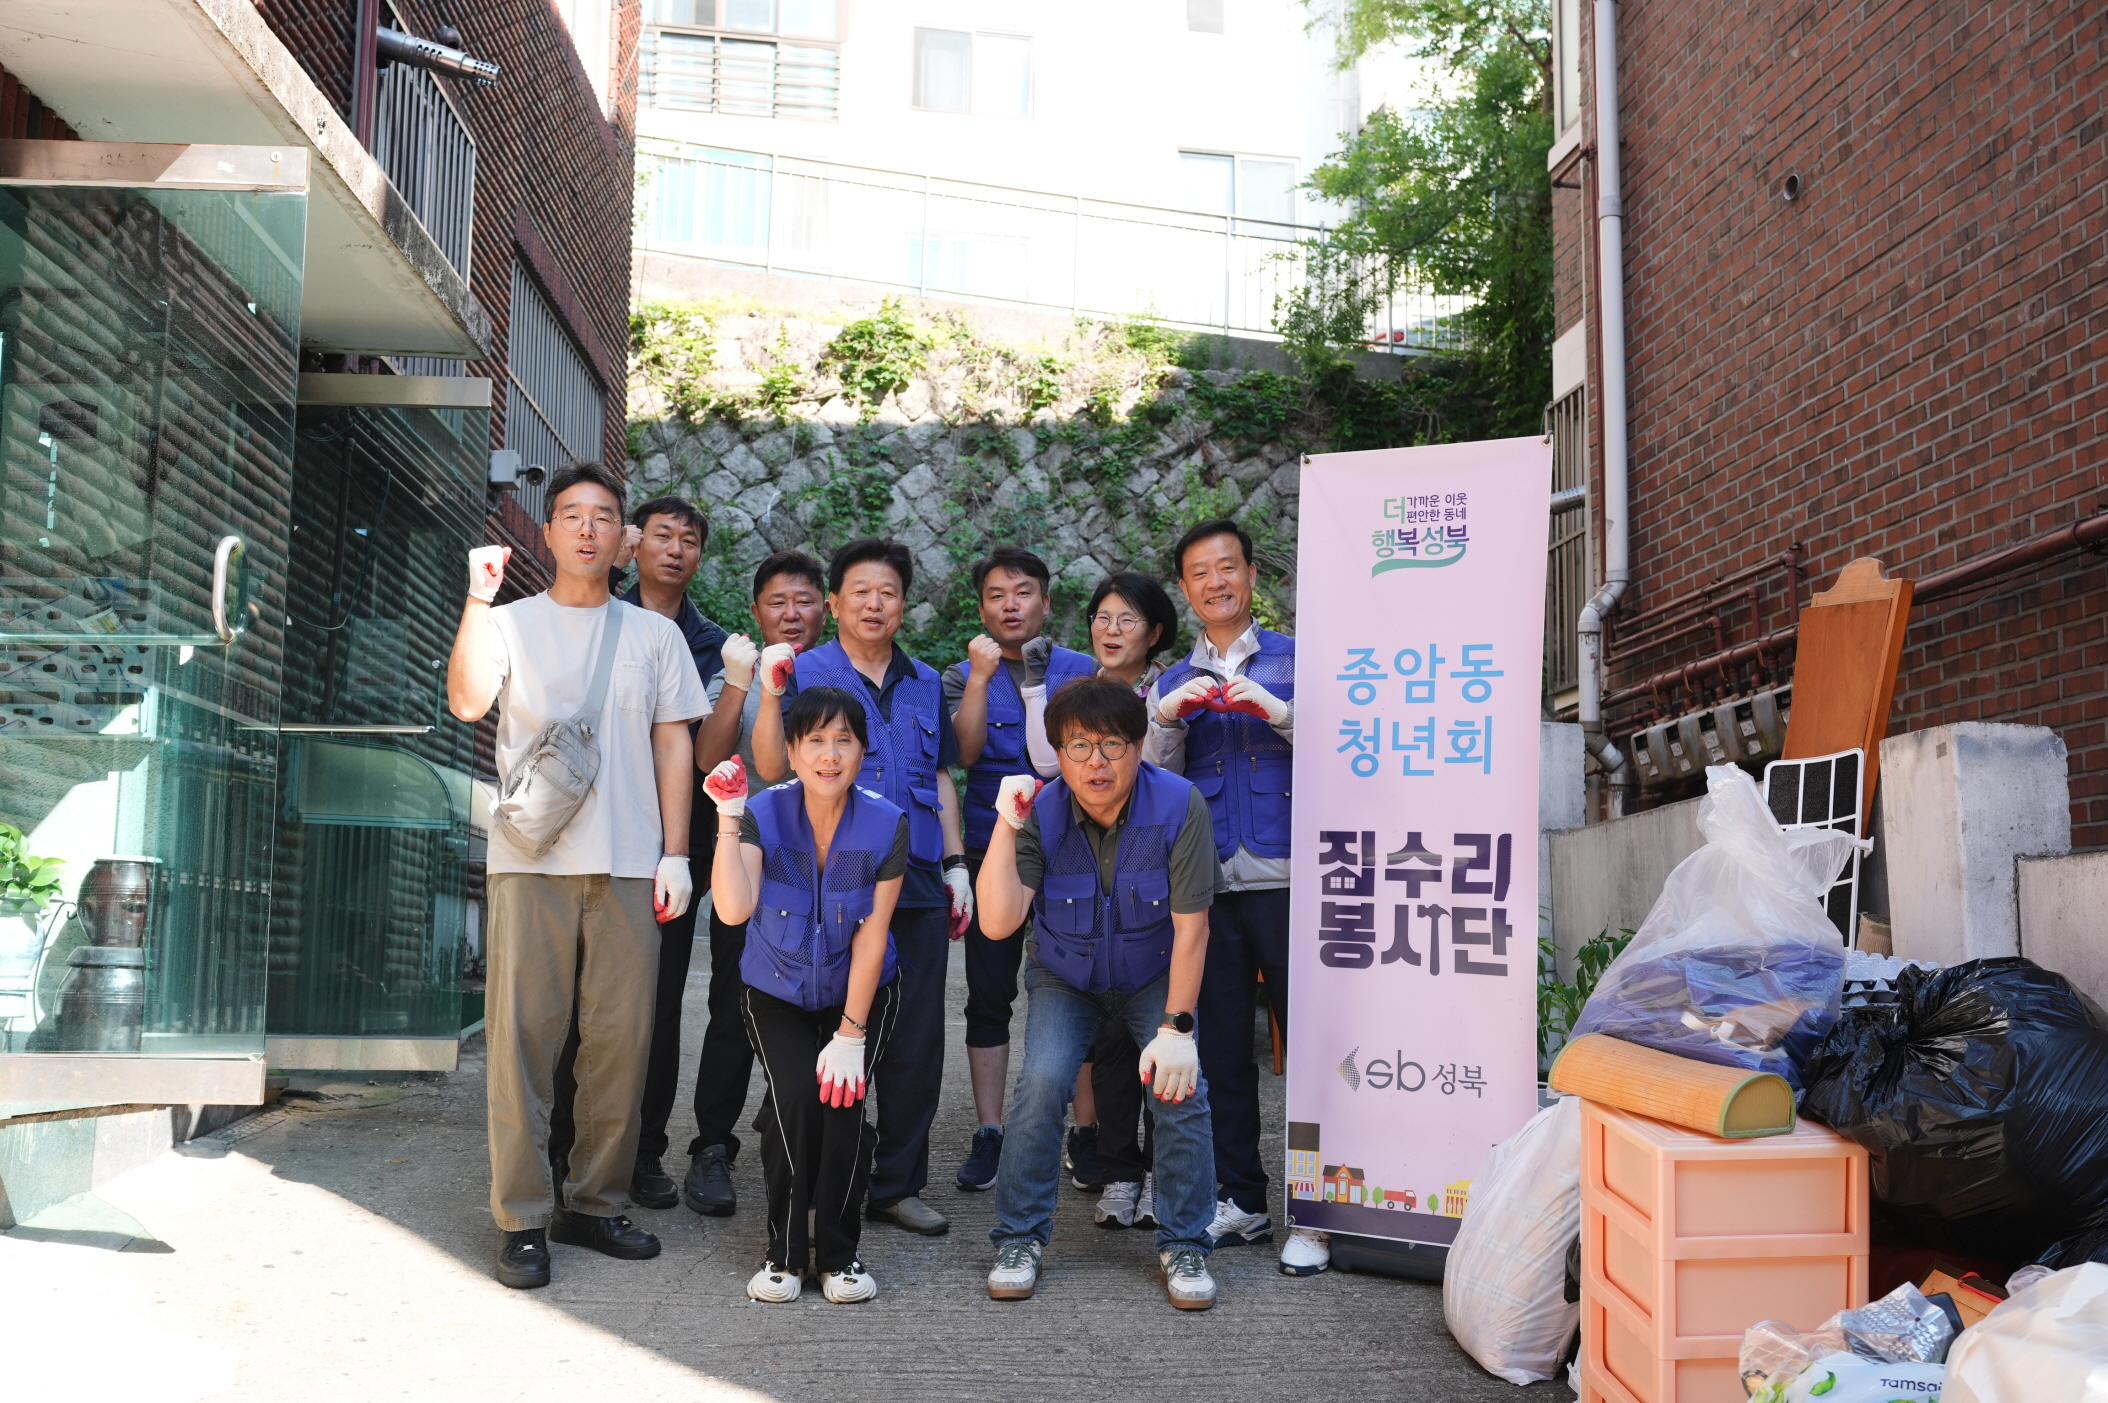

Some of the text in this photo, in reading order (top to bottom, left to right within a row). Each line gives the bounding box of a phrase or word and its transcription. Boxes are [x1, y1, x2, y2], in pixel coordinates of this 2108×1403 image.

[1383, 496, 1405, 524] 더
[1406, 492, 1468, 508] 가까운 이웃
[1406, 507, 1467, 523] 편안한 동네
[1336, 643, 1504, 706] 종암동
[1336, 715, 1493, 778] 청년회
[1318, 830, 1512, 902] 집수리
[1318, 901, 1513, 977] 봉사단
[1365, 1049, 1488, 1099] sb 성북
